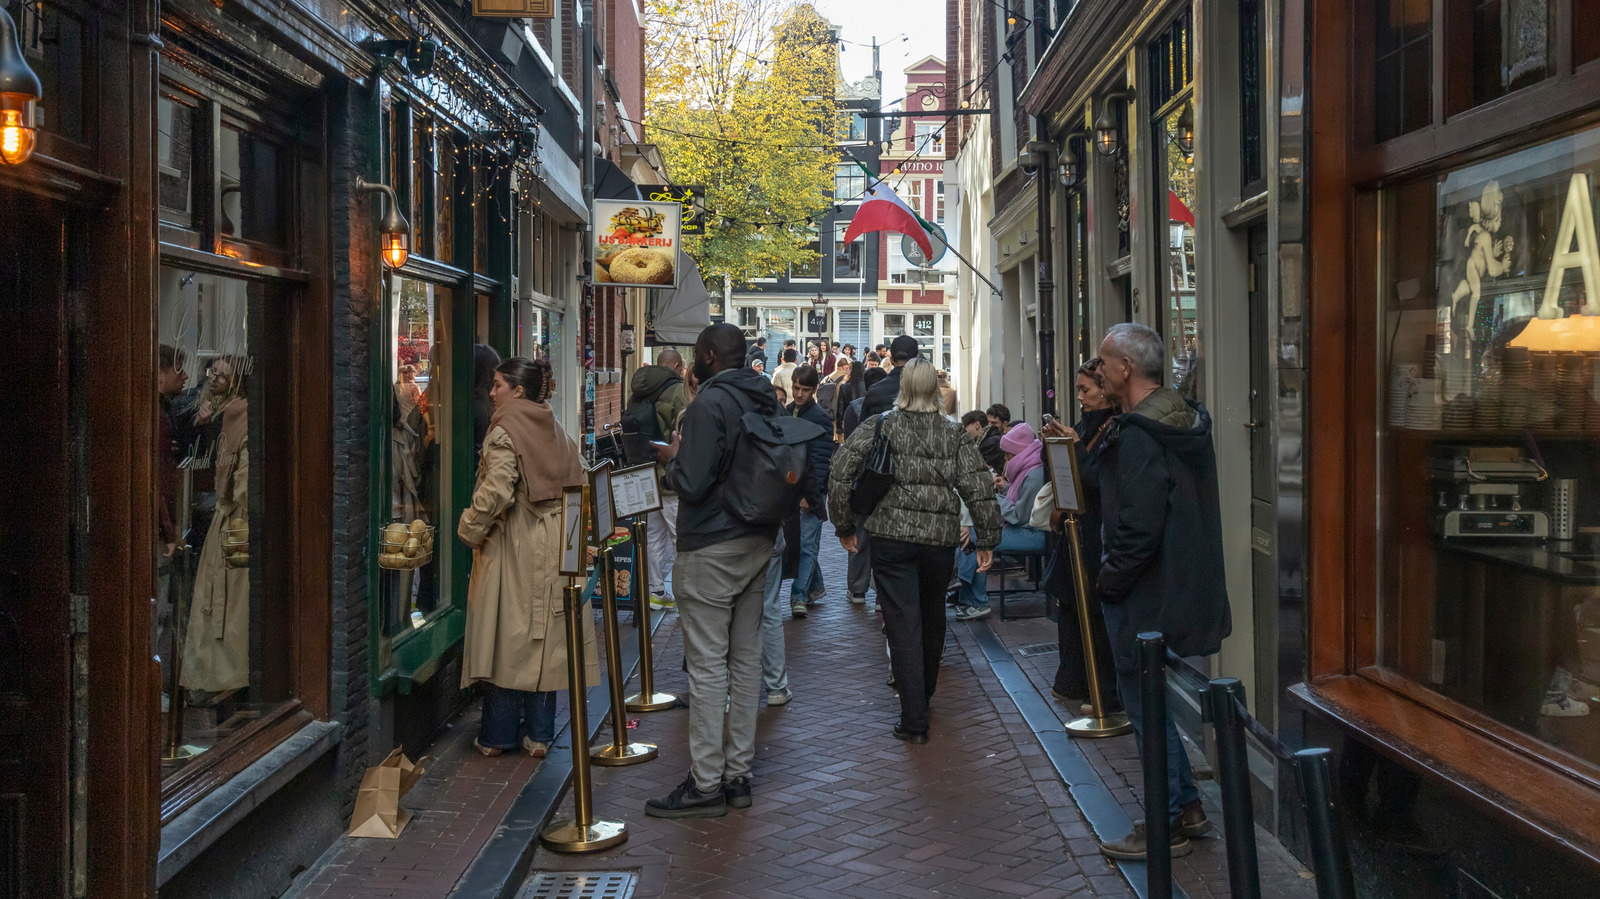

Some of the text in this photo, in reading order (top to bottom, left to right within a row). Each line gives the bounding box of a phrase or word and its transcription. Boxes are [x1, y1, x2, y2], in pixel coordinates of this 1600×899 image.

[598, 235, 673, 247] IJS BAKKERIJ
[915, 320, 932, 329] 412
